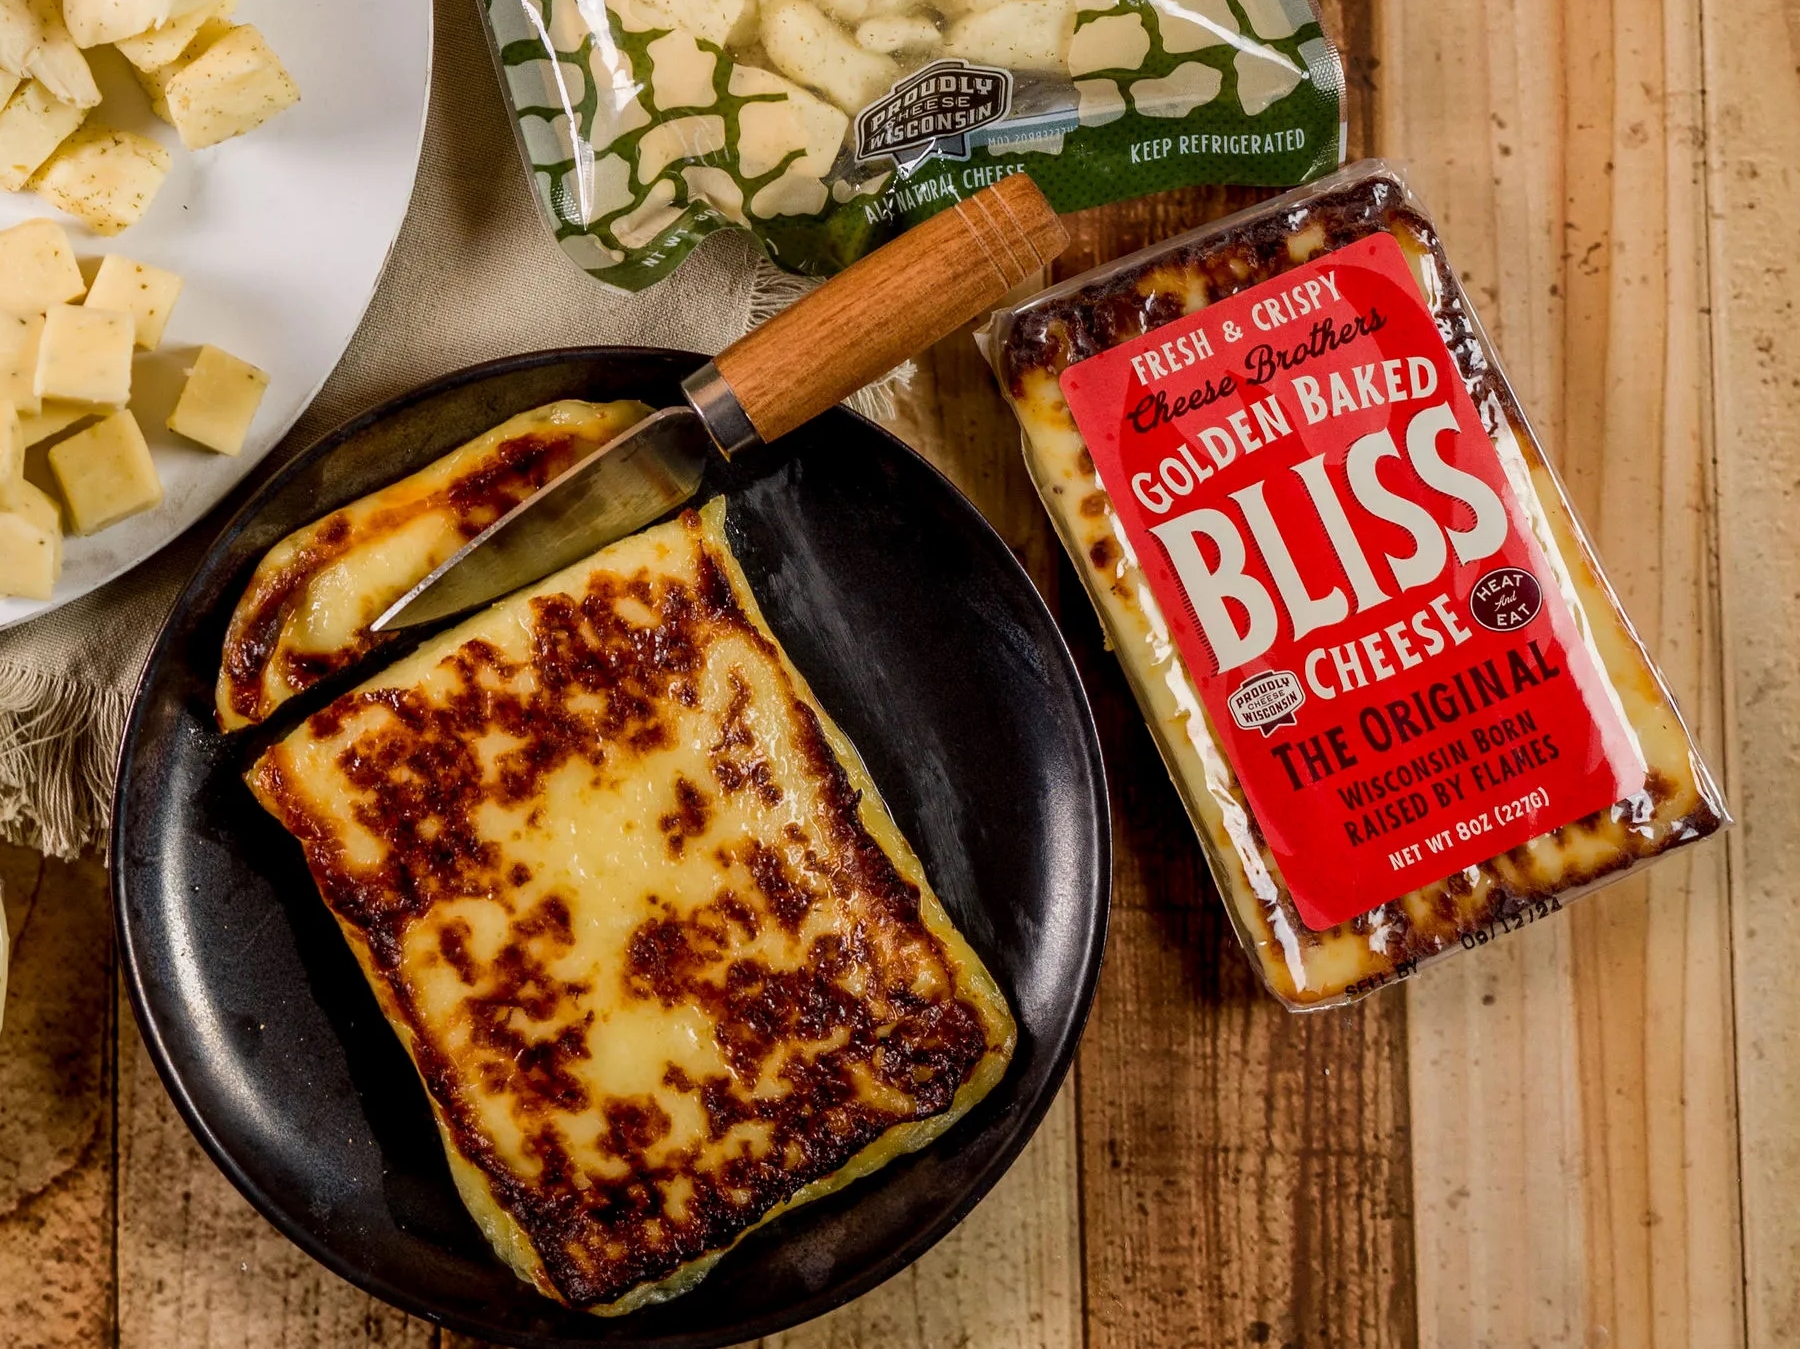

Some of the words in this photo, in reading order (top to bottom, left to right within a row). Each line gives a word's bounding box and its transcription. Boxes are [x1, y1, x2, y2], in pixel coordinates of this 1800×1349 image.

[870, 102, 993, 151] WISCONSIN
[871, 76, 993, 132] PROUDLY
[1130, 138, 1172, 164] KEEP
[1179, 128, 1306, 155] REFRIGERATED
[895, 173, 957, 214] NATURAL
[641, 250, 667, 269] NT
[663, 227, 690, 248] WT
[1129, 326, 1215, 387] FRESH
[1222, 318, 1244, 342] &
[1250, 270, 1343, 333] CRISPY
[1126, 369, 1237, 434] Cheese
[1243, 306, 1388, 387] Brothers
[1131, 394, 1293, 516] GOLDEN
[1291, 355, 1438, 426] BAKED
[1147, 401, 1509, 673] BLISS
[1476, 574, 1524, 602] HEAT
[1494, 589, 1517, 612] And
[1496, 602, 1530, 626] EAT
[1304, 593, 1473, 701] CHEESE
[1235, 677, 1290, 709] PROUDLY
[1241, 690, 1298, 723] WISCONSIN
[1247, 689, 1286, 711] CHEESE
[1271, 726, 1359, 792] THE
[1358, 639, 1561, 753] ORIGINAL
[1336, 739, 1470, 812] WISCONSIN
[1471, 708, 1538, 756] BORN
[1343, 792, 1429, 848] RAISED
[1431, 773, 1466, 809] BY
[1470, 733, 1560, 793] FLAMES
[1388, 843, 1423, 872] NET
[1425, 829, 1455, 855] WT
[1493, 786, 1550, 827] (227G)
[1395, 955, 1418, 979] BY
